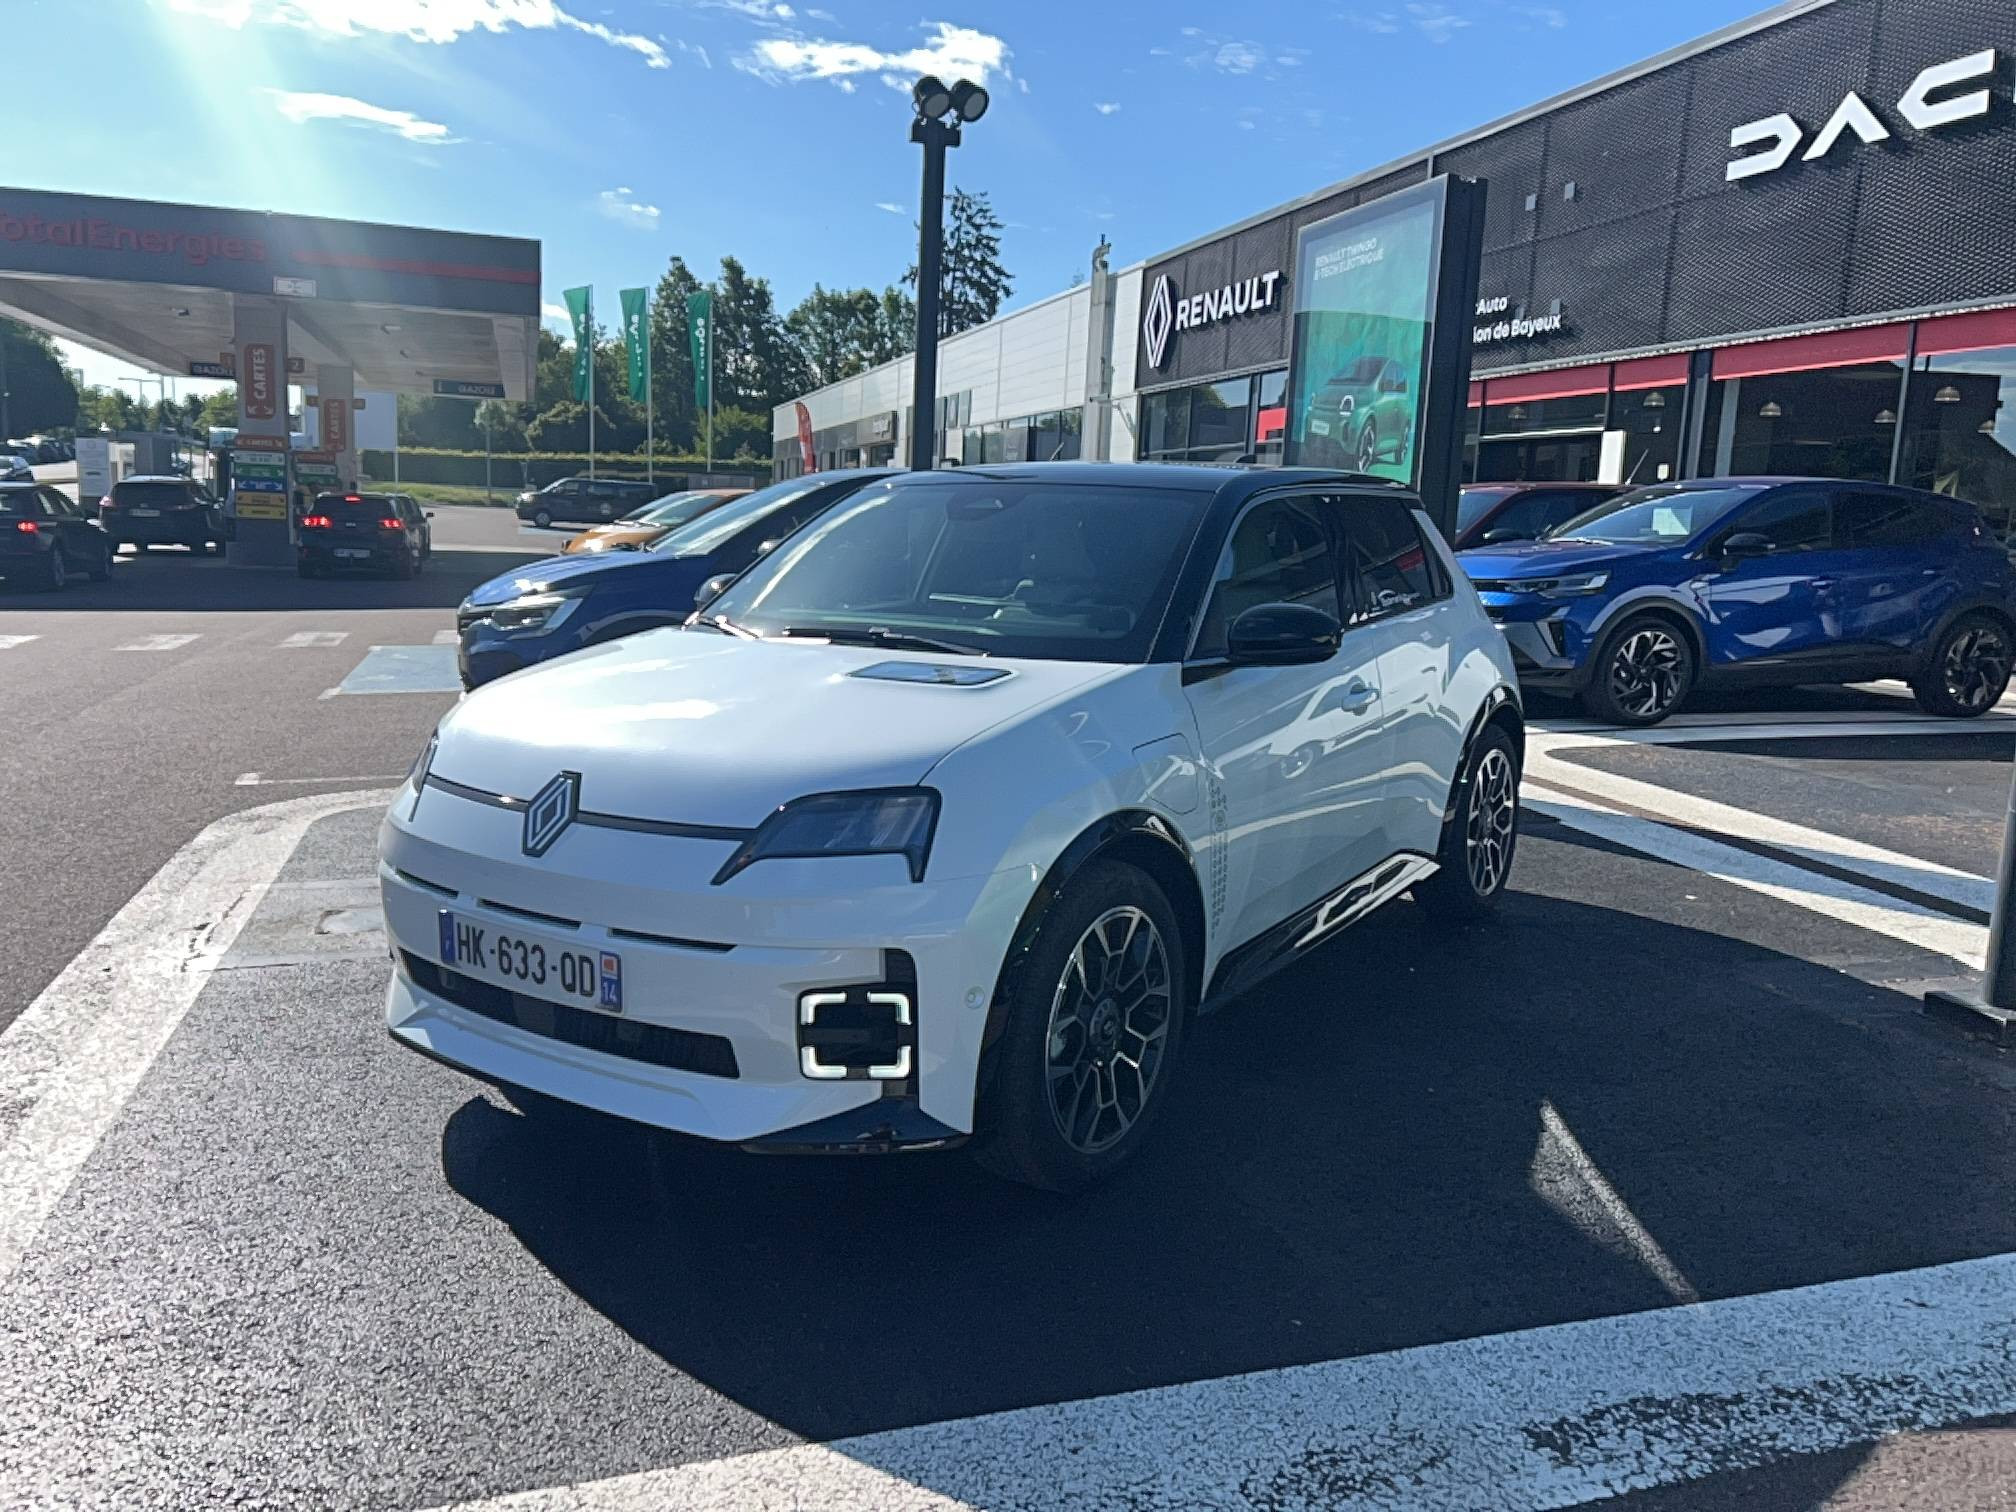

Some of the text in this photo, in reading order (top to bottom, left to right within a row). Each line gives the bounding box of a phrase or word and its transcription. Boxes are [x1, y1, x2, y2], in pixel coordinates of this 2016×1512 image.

[1725, 48, 2016, 181] DAC
[1175, 270, 1280, 331] RENAULT
[1474, 296, 1509, 315] Auto
[1493, 320, 1510, 339] de
[1511, 313, 1561, 338] Bayeux
[252, 348, 266, 400] CARTES
[457, 922, 596, 998] HK-633-QD
[603, 981, 616, 1003] 14
